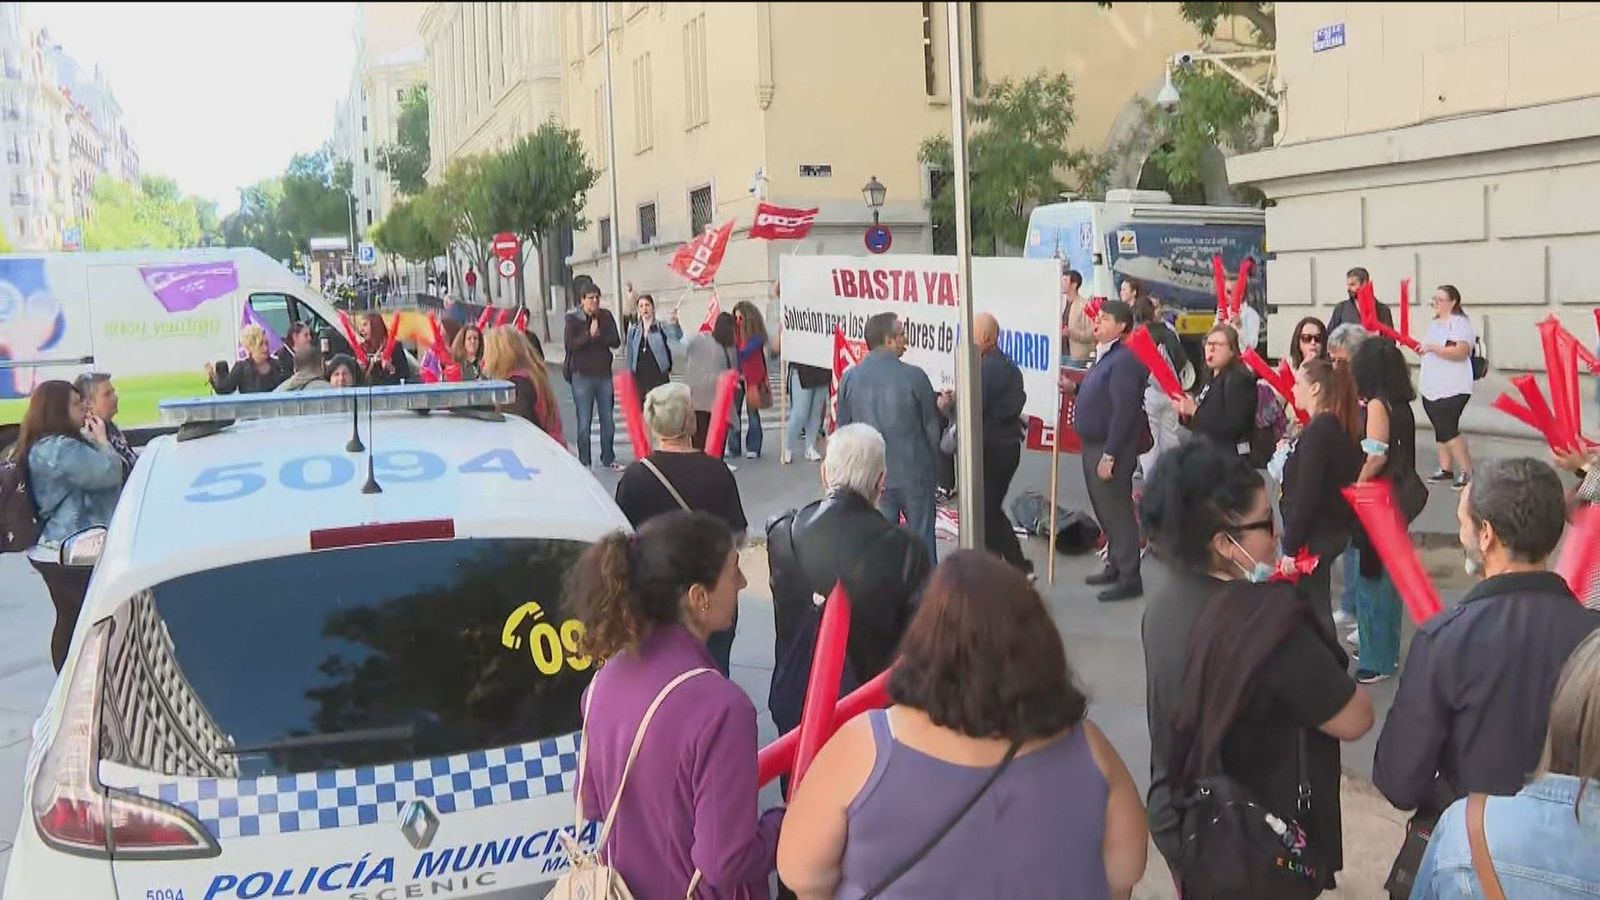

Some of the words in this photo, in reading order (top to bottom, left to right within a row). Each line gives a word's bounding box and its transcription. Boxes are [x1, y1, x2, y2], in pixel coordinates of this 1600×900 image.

[784, 304, 823, 335] Solucion
[825, 312, 847, 337] para
[849, 310, 864, 339] los
[937, 320, 953, 354] de
[184, 448, 541, 503] 5094
[529, 618, 593, 675] 09
[204, 852, 395, 900] POLICÍA
[412, 819, 599, 879] MUNICIPA
[541, 856, 571, 873] MA
[146, 889, 184, 900] 5094
[349, 871, 497, 900] SCENIC
